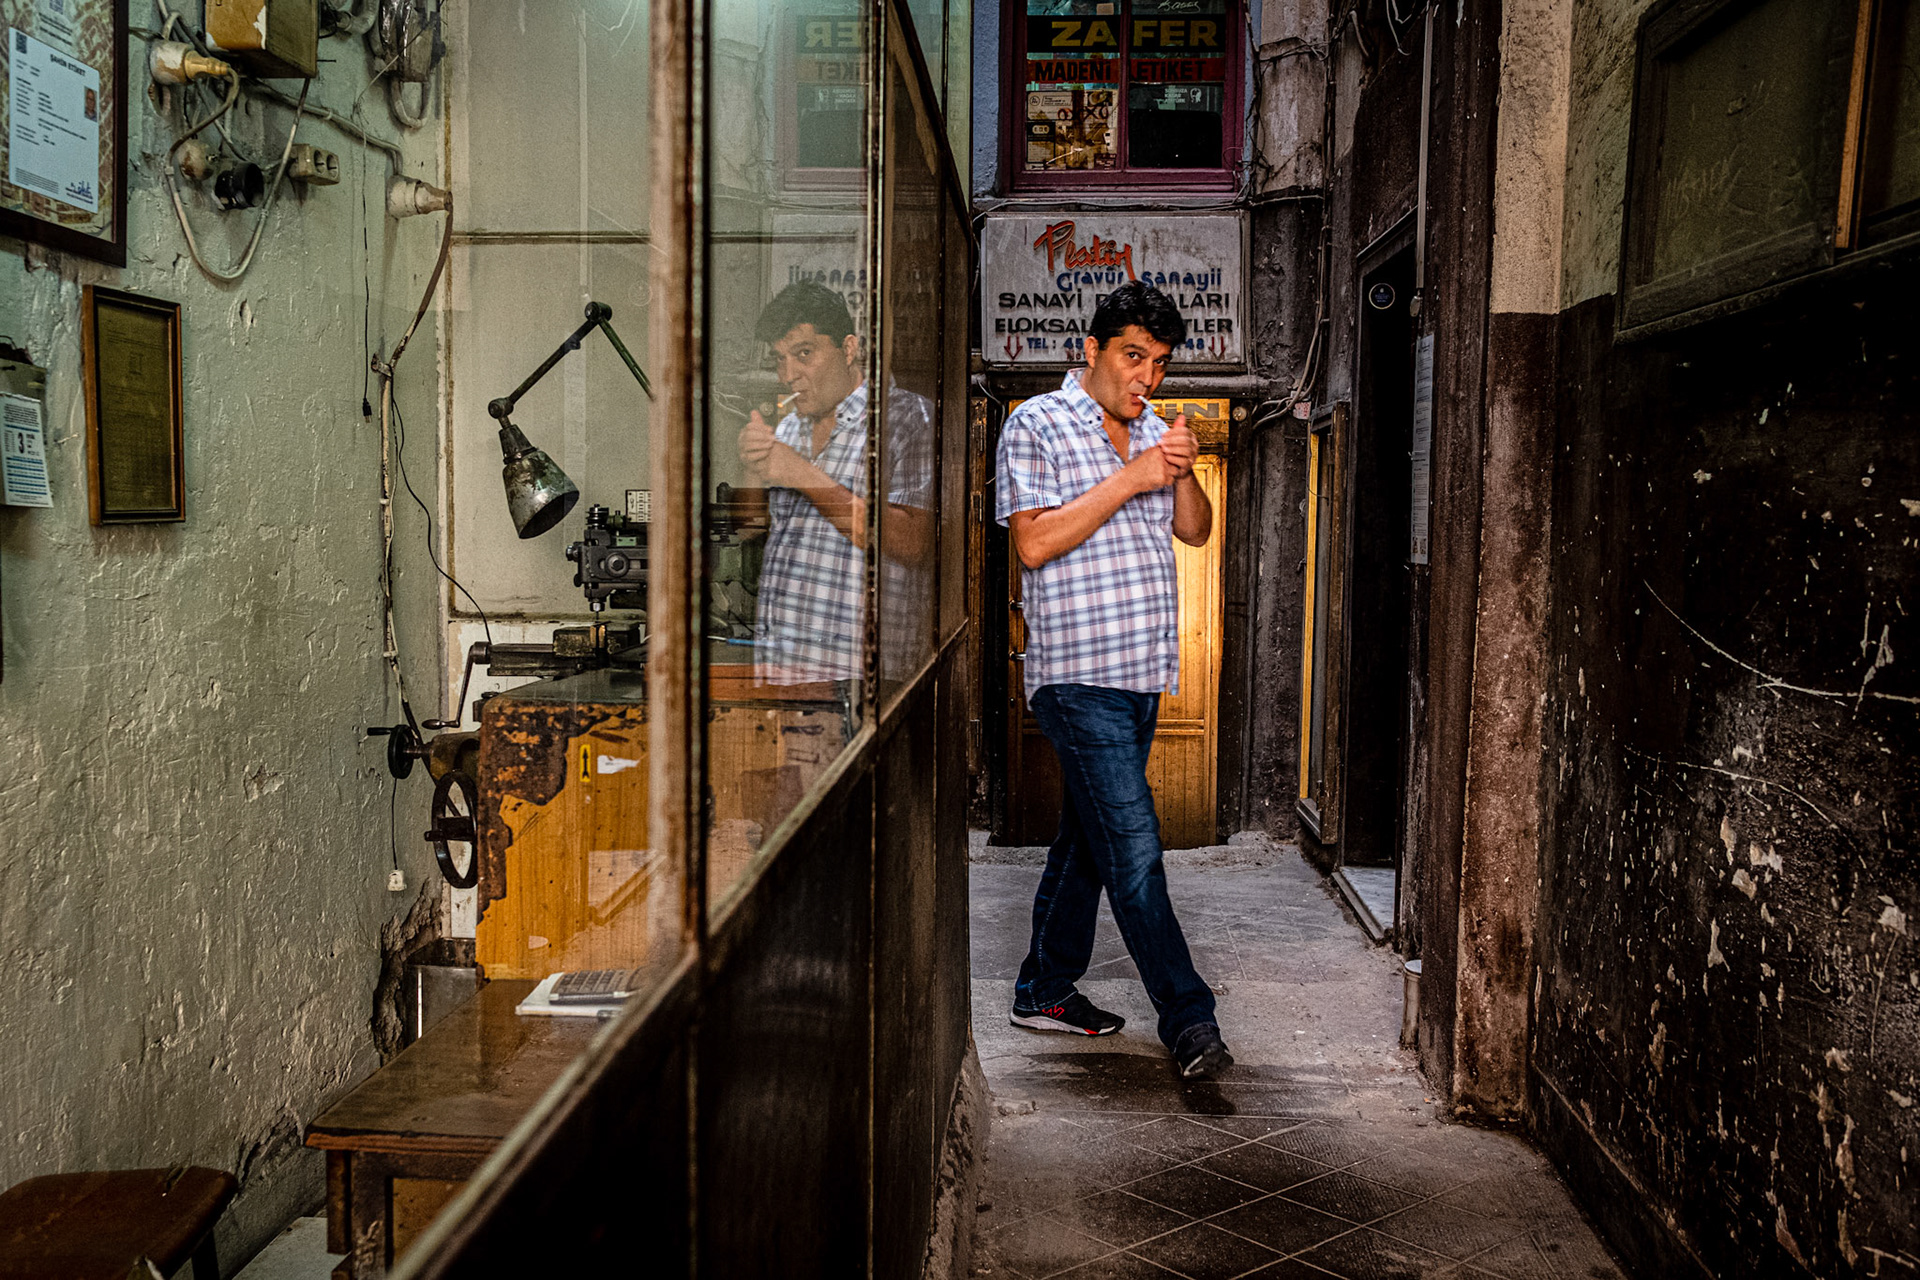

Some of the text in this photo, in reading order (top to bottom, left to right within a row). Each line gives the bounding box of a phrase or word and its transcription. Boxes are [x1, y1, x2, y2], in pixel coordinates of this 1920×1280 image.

[1133, 20, 1219, 47] FER
[1035, 60, 1111, 82] MADENİ
[1034, 220, 1136, 281] Platin
[998, 288, 1082, 309] SANAYİ
